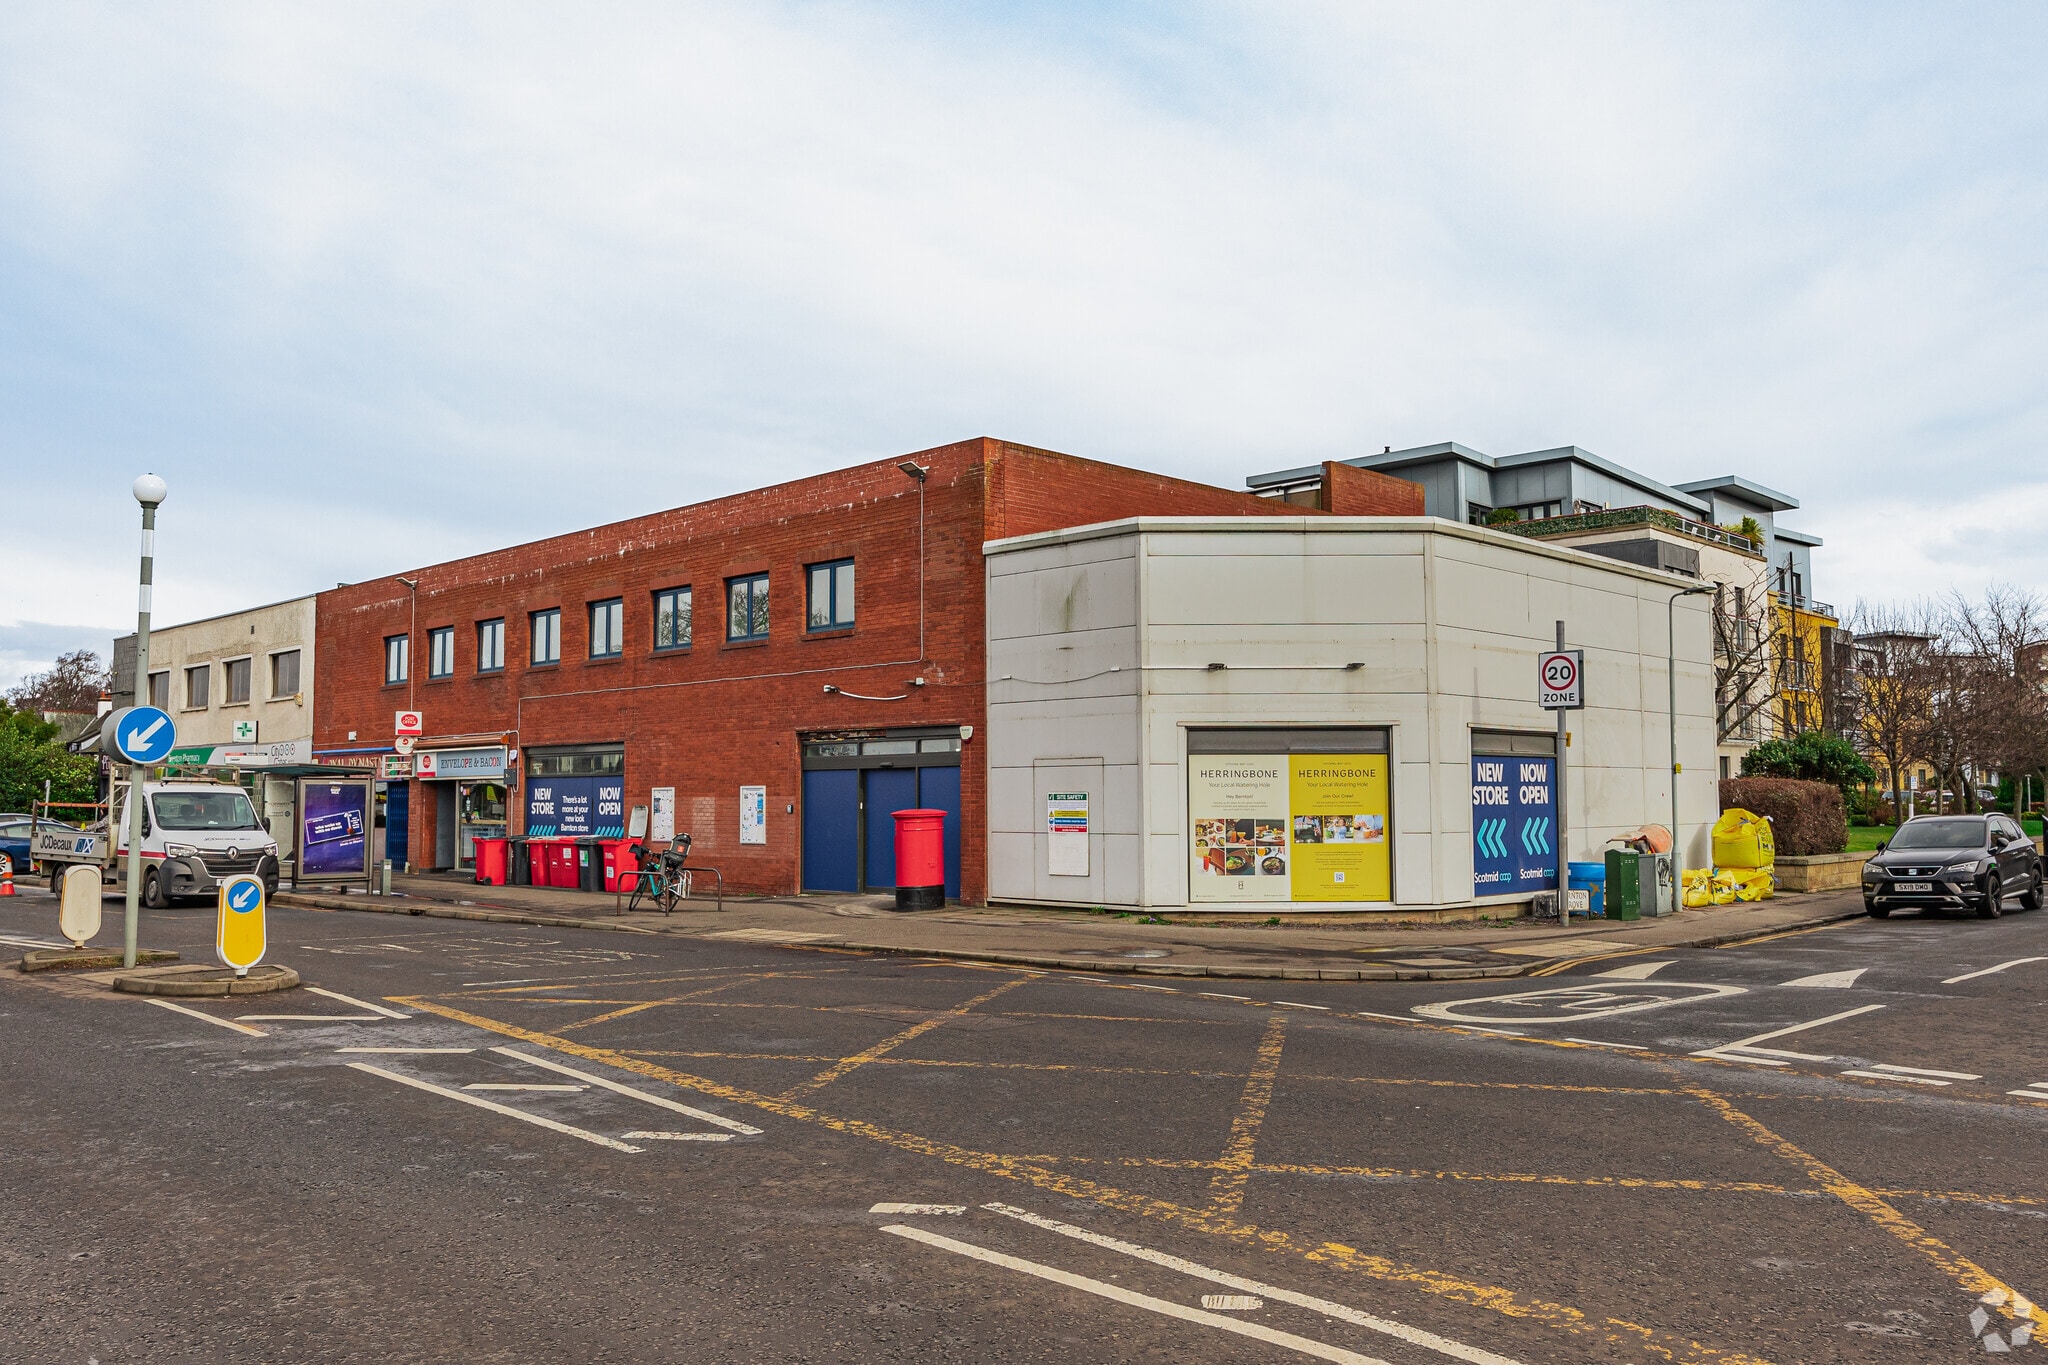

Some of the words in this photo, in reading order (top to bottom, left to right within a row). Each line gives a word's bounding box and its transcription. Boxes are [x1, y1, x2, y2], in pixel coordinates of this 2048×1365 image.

[1548, 666, 1571, 680] 20
[1544, 692, 1575, 702] ZONE
[441, 758, 472, 768] ENVELOPE
[474, 758, 479, 767] &
[480, 756, 502, 767] BACON
[1200, 770, 1278, 778] HERRINGBONE
[1298, 769, 1376, 777] HERRINGBONE
[1477, 763, 1504, 782] NEW
[1520, 764, 1546, 782] NOW
[534, 788, 552, 800] NEW
[600, 787, 620, 800] NOW
[1473, 786, 1509, 805] STORE
[1520, 786, 1548, 804] OPEN
[531, 802, 554, 814] STORE
[598, 802, 620, 815] OPEN
[40, 835, 72, 850] JCDecaux
[1474, 871, 1499, 883] Scotmid
[1520, 868, 1543, 879] Scotmid
